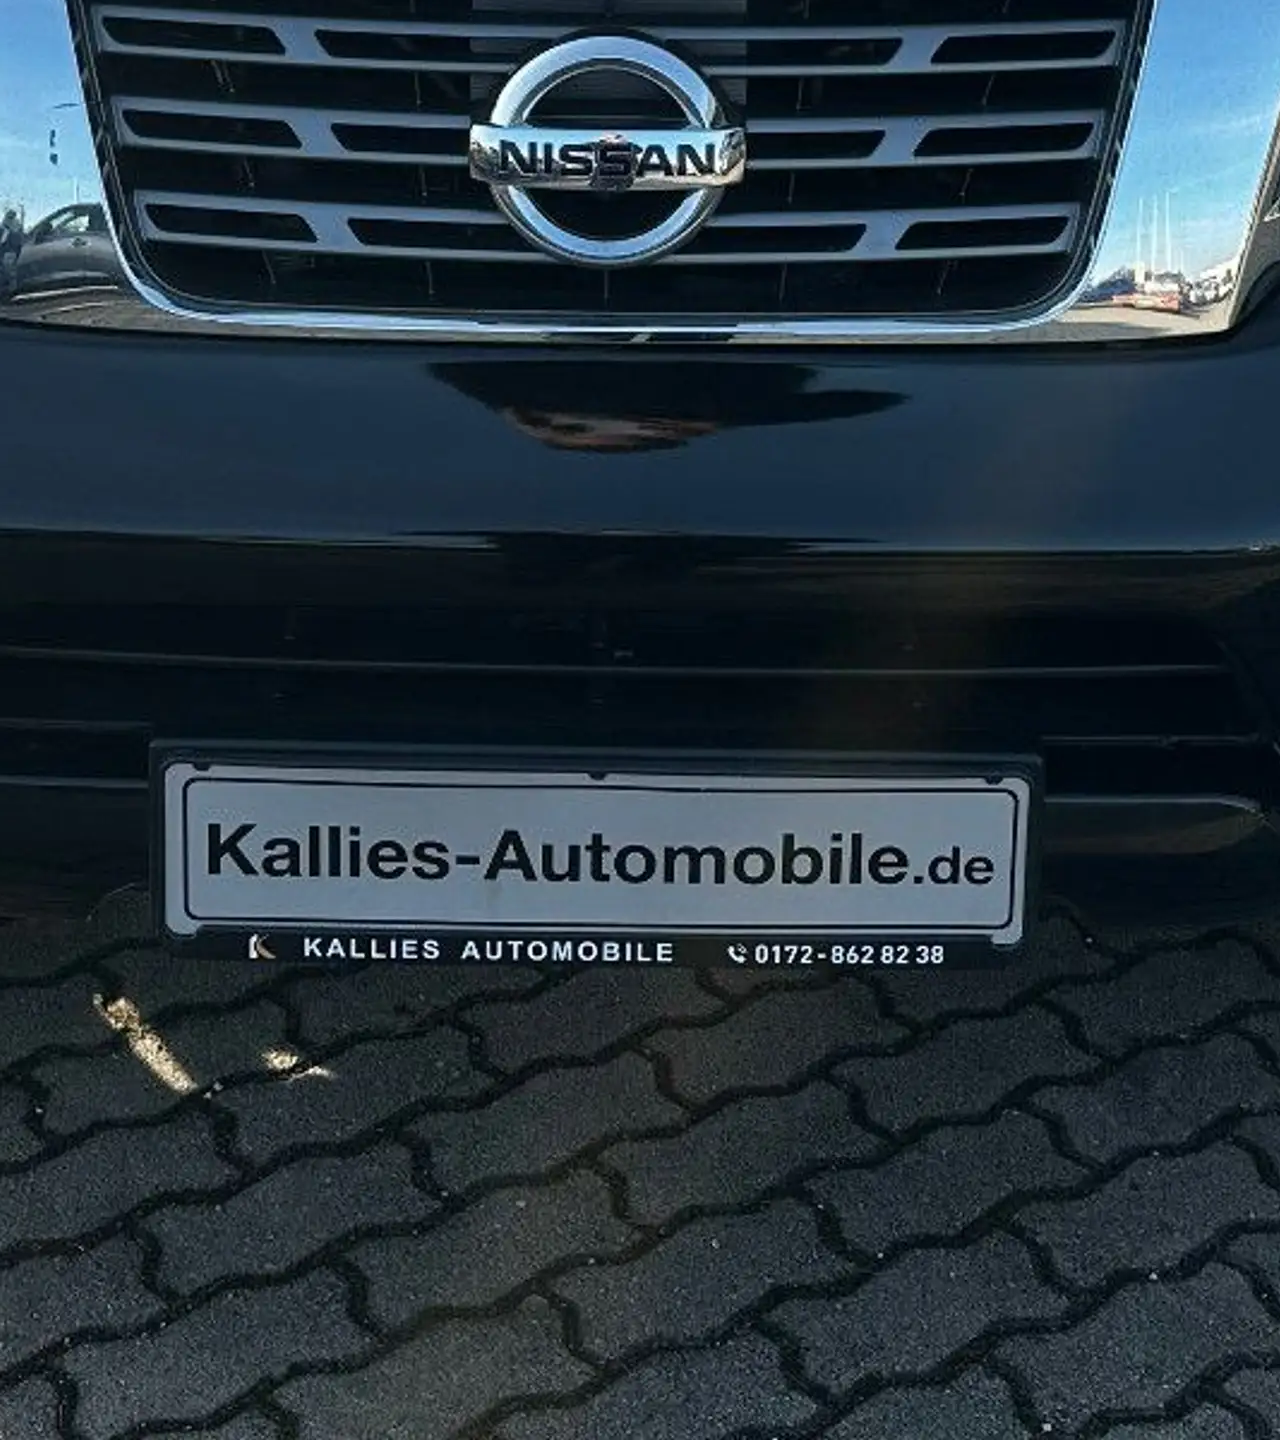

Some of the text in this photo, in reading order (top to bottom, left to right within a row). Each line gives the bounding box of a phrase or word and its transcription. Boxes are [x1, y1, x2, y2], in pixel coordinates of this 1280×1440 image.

[499, 139, 716, 177] NISSAN
[207, 823, 995, 885] Kallies-Automobile.de
[303, 938, 440, 959] KALLIES
[460, 941, 674, 962] AUTOMOBILE
